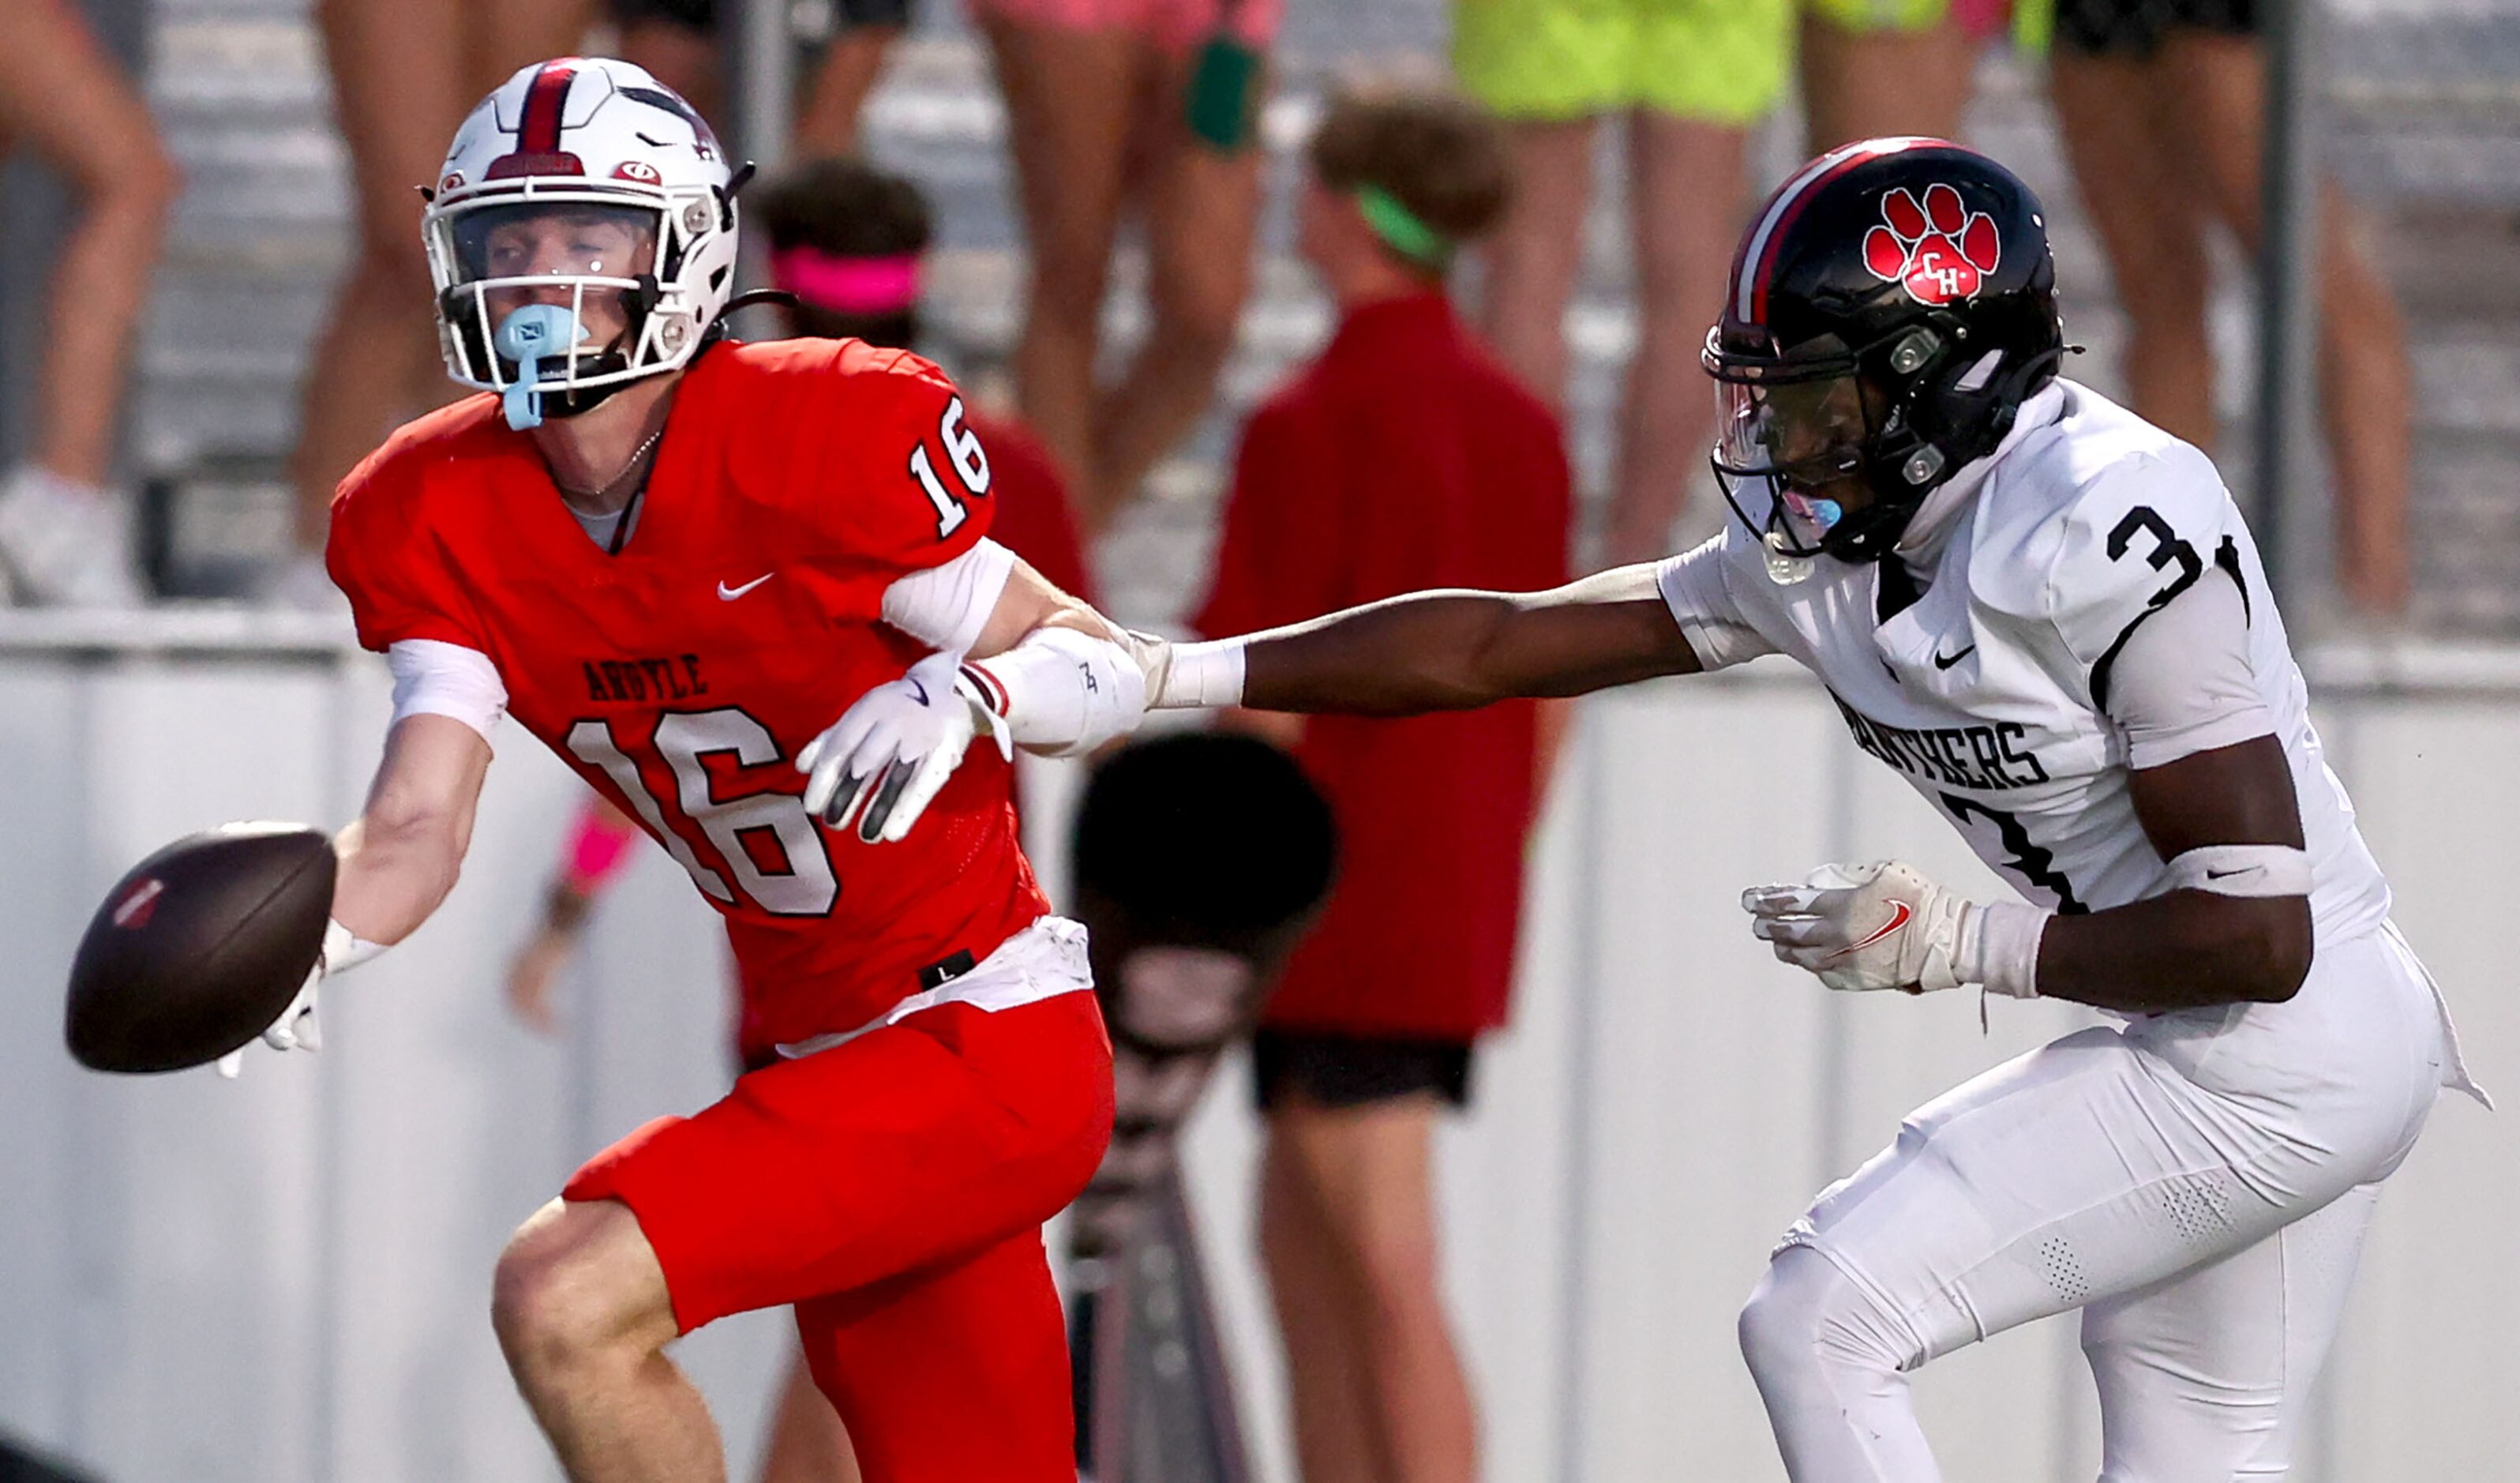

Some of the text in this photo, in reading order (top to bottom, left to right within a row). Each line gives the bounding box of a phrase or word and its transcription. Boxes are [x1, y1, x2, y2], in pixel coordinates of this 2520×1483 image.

[909, 392, 992, 540] 16
[2106, 505, 2203, 607] 3
[583, 653, 708, 701] ARGYLE
[564, 706, 841, 918] 16
[937, 966, 955, 982] L
